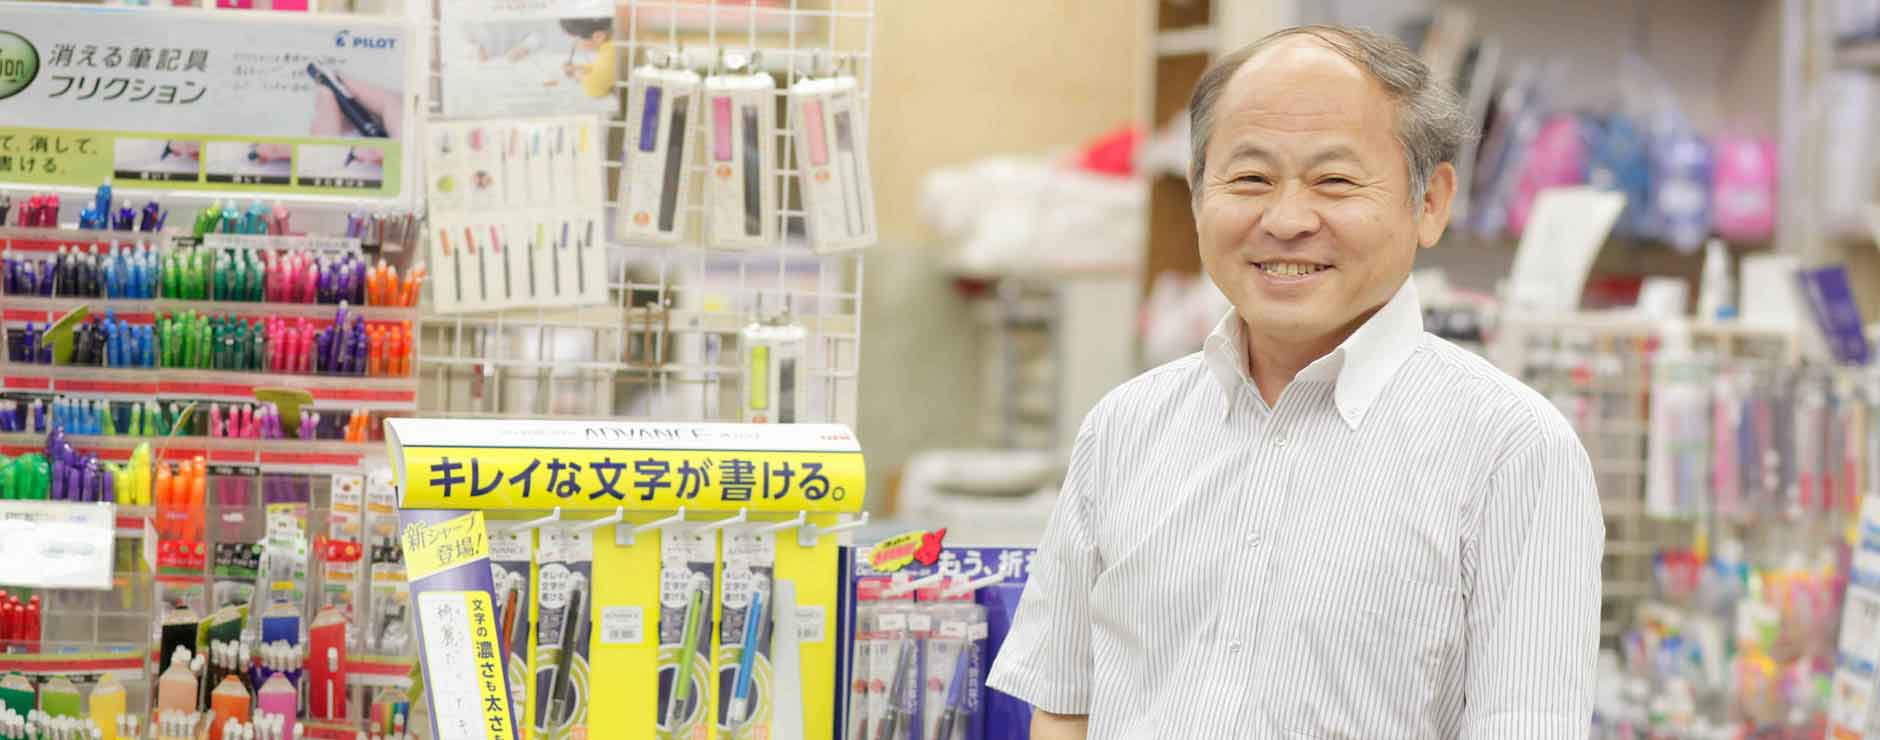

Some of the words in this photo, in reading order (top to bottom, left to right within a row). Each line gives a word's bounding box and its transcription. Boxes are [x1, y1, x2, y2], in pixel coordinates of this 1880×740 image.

[353, 37, 397, 49] PILOT
[48, 44, 208, 72] 消える筆記具
[48, 75, 207, 104] フリクション
[429, 456, 846, 502] キレイな文字が書ける。
[472, 599, 505, 740] 文字の濃さも太さ
